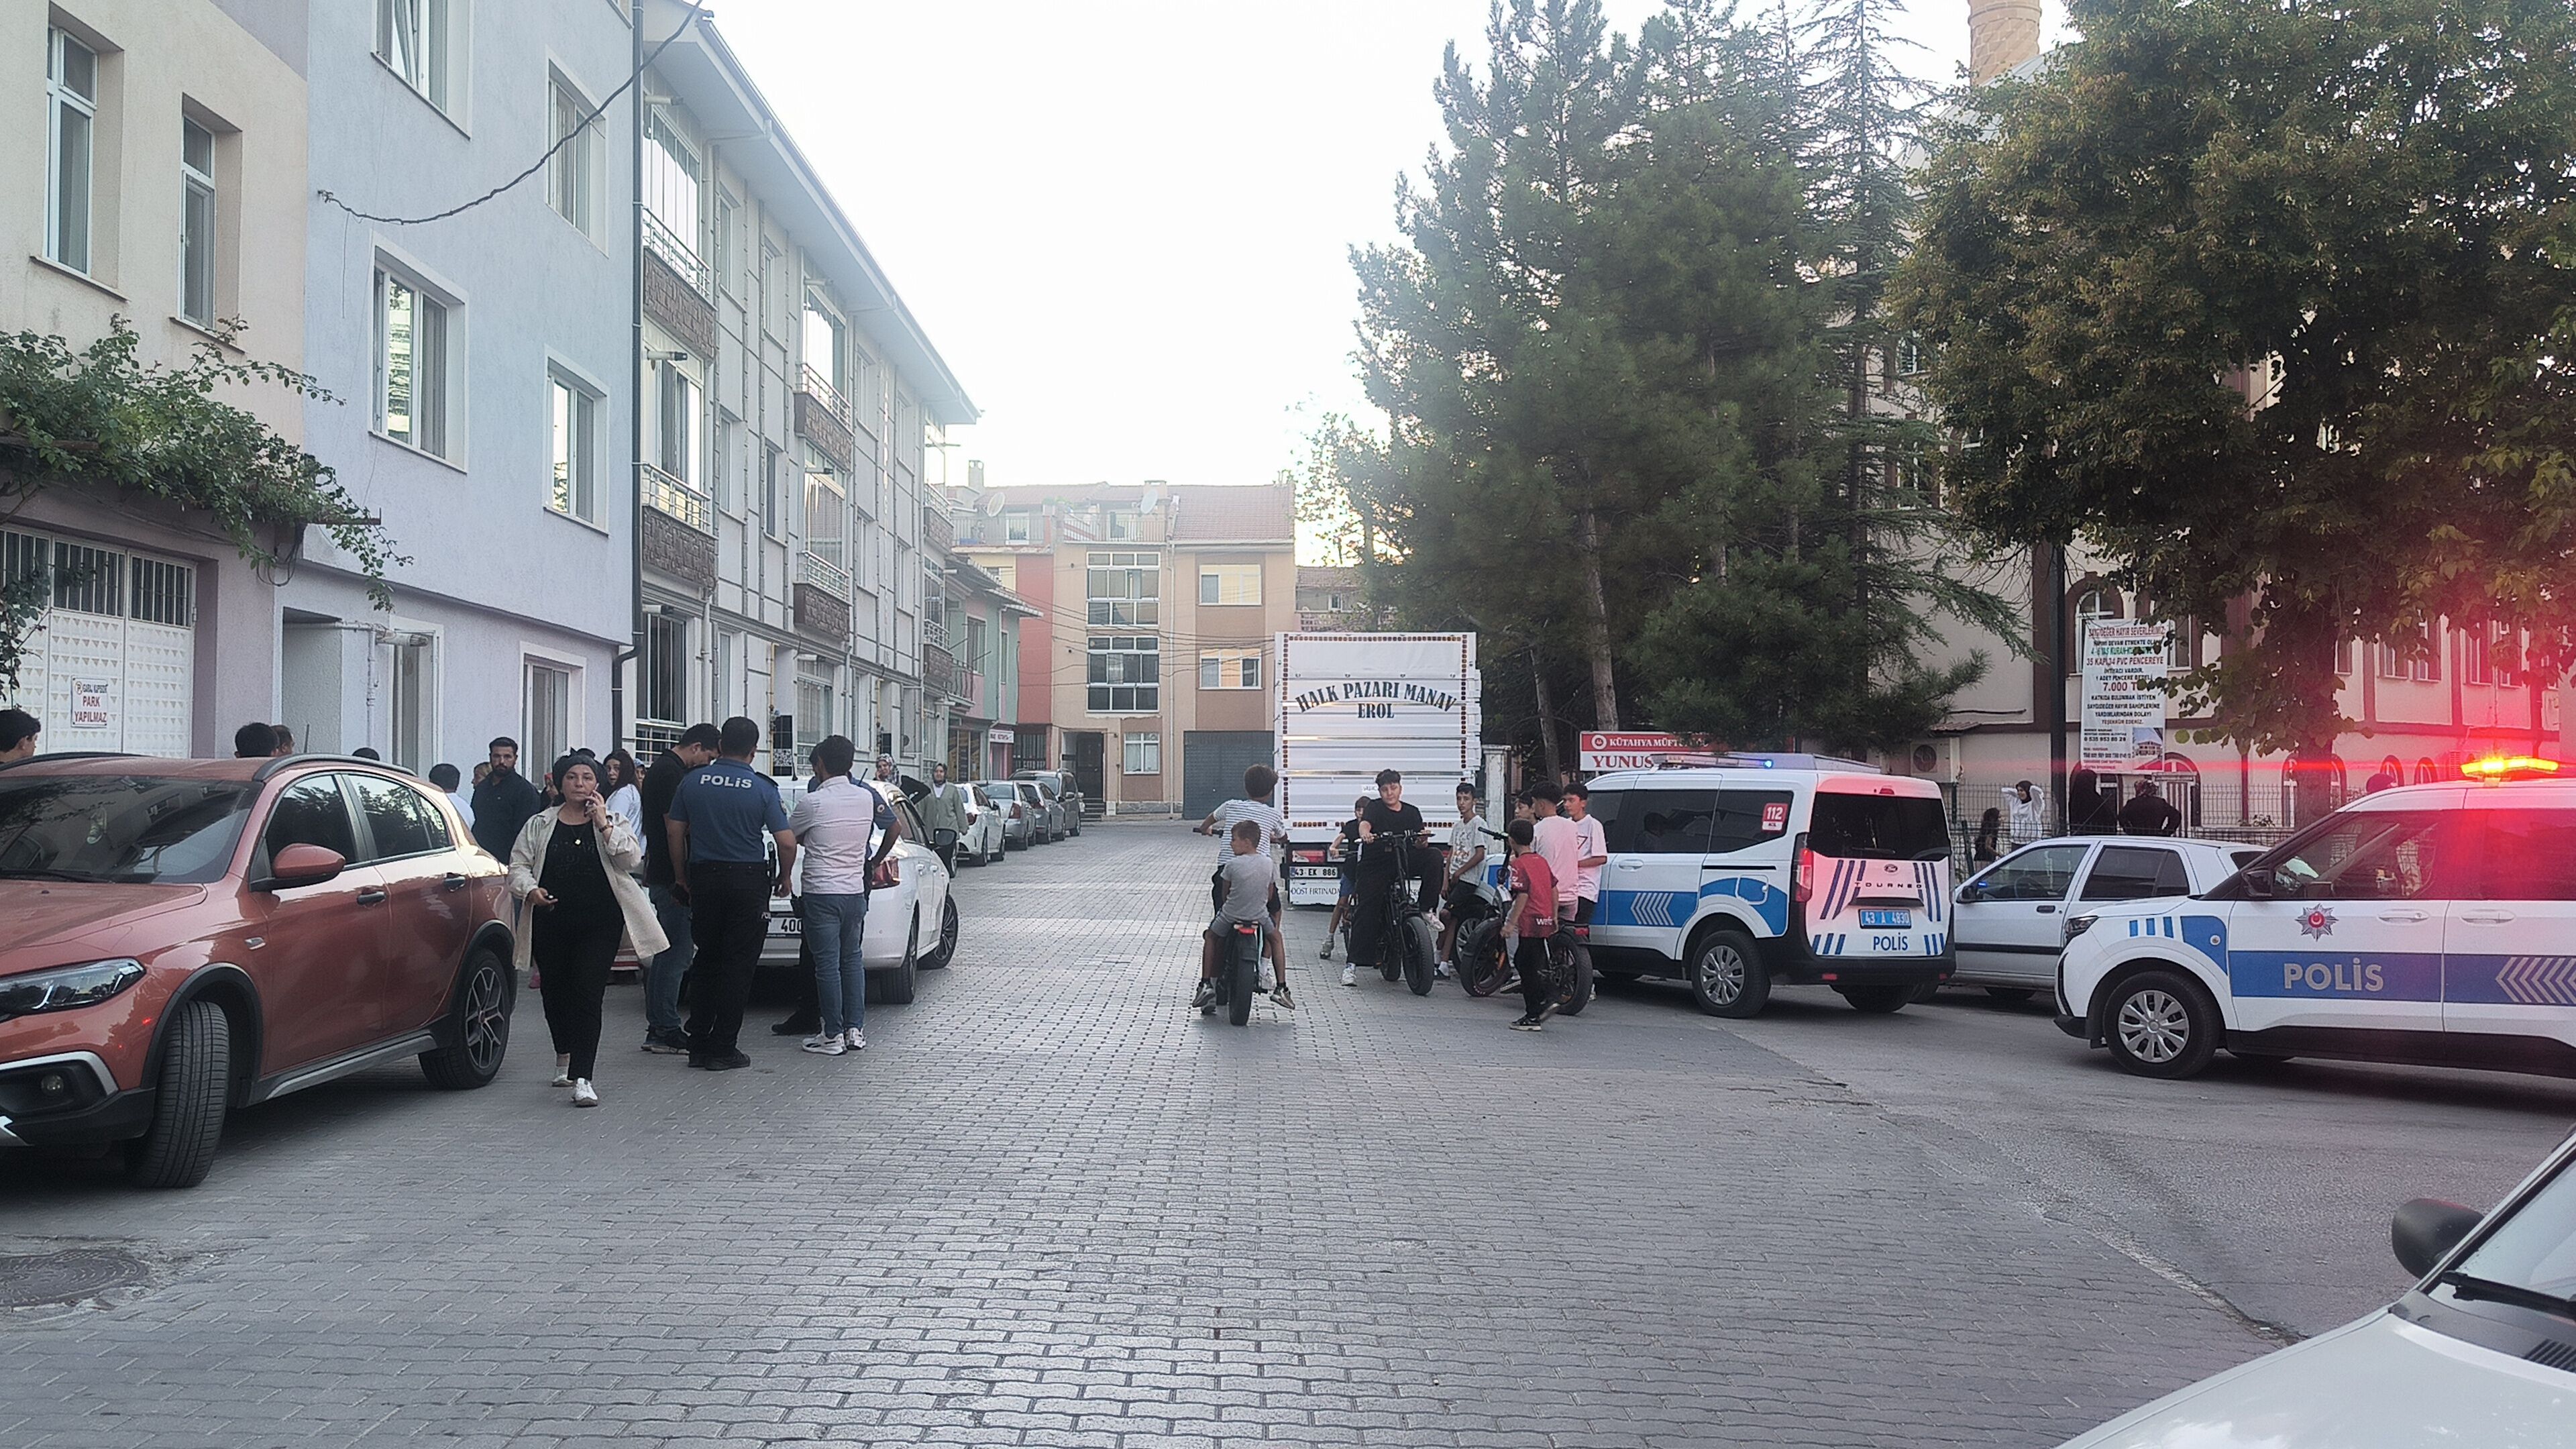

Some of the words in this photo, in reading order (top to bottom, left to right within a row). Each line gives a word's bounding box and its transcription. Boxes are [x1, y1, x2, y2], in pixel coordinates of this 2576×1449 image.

[2116, 657, 2128, 665] PVC
[2129, 657, 2164, 665] PENCEREYE
[2103, 682, 2127, 692] 7.000
[83, 696, 100, 707] PARK
[1295, 685, 1340, 713] HALK
[1343, 681, 1400, 699] PAZARI
[1404, 684, 1457, 712] MANAV
[74, 711, 107, 722] YAPILMAZ
[1358, 703, 1395, 718] EROL
[1610, 737, 1652, 747] KÜTAHYA
[1593, 755, 1654, 767] YUNUS
[1767, 807, 1783, 820] 112
[1295, 868, 1304, 876] 43
[1308, 868, 1317, 876] EK
[1322, 867, 1336, 876] 886
[1865, 912, 1876, 924] 43
[1881, 912, 1886, 924] A
[1873, 932, 1909, 951] POLİS
[2284, 957, 2384, 992] POLİS
